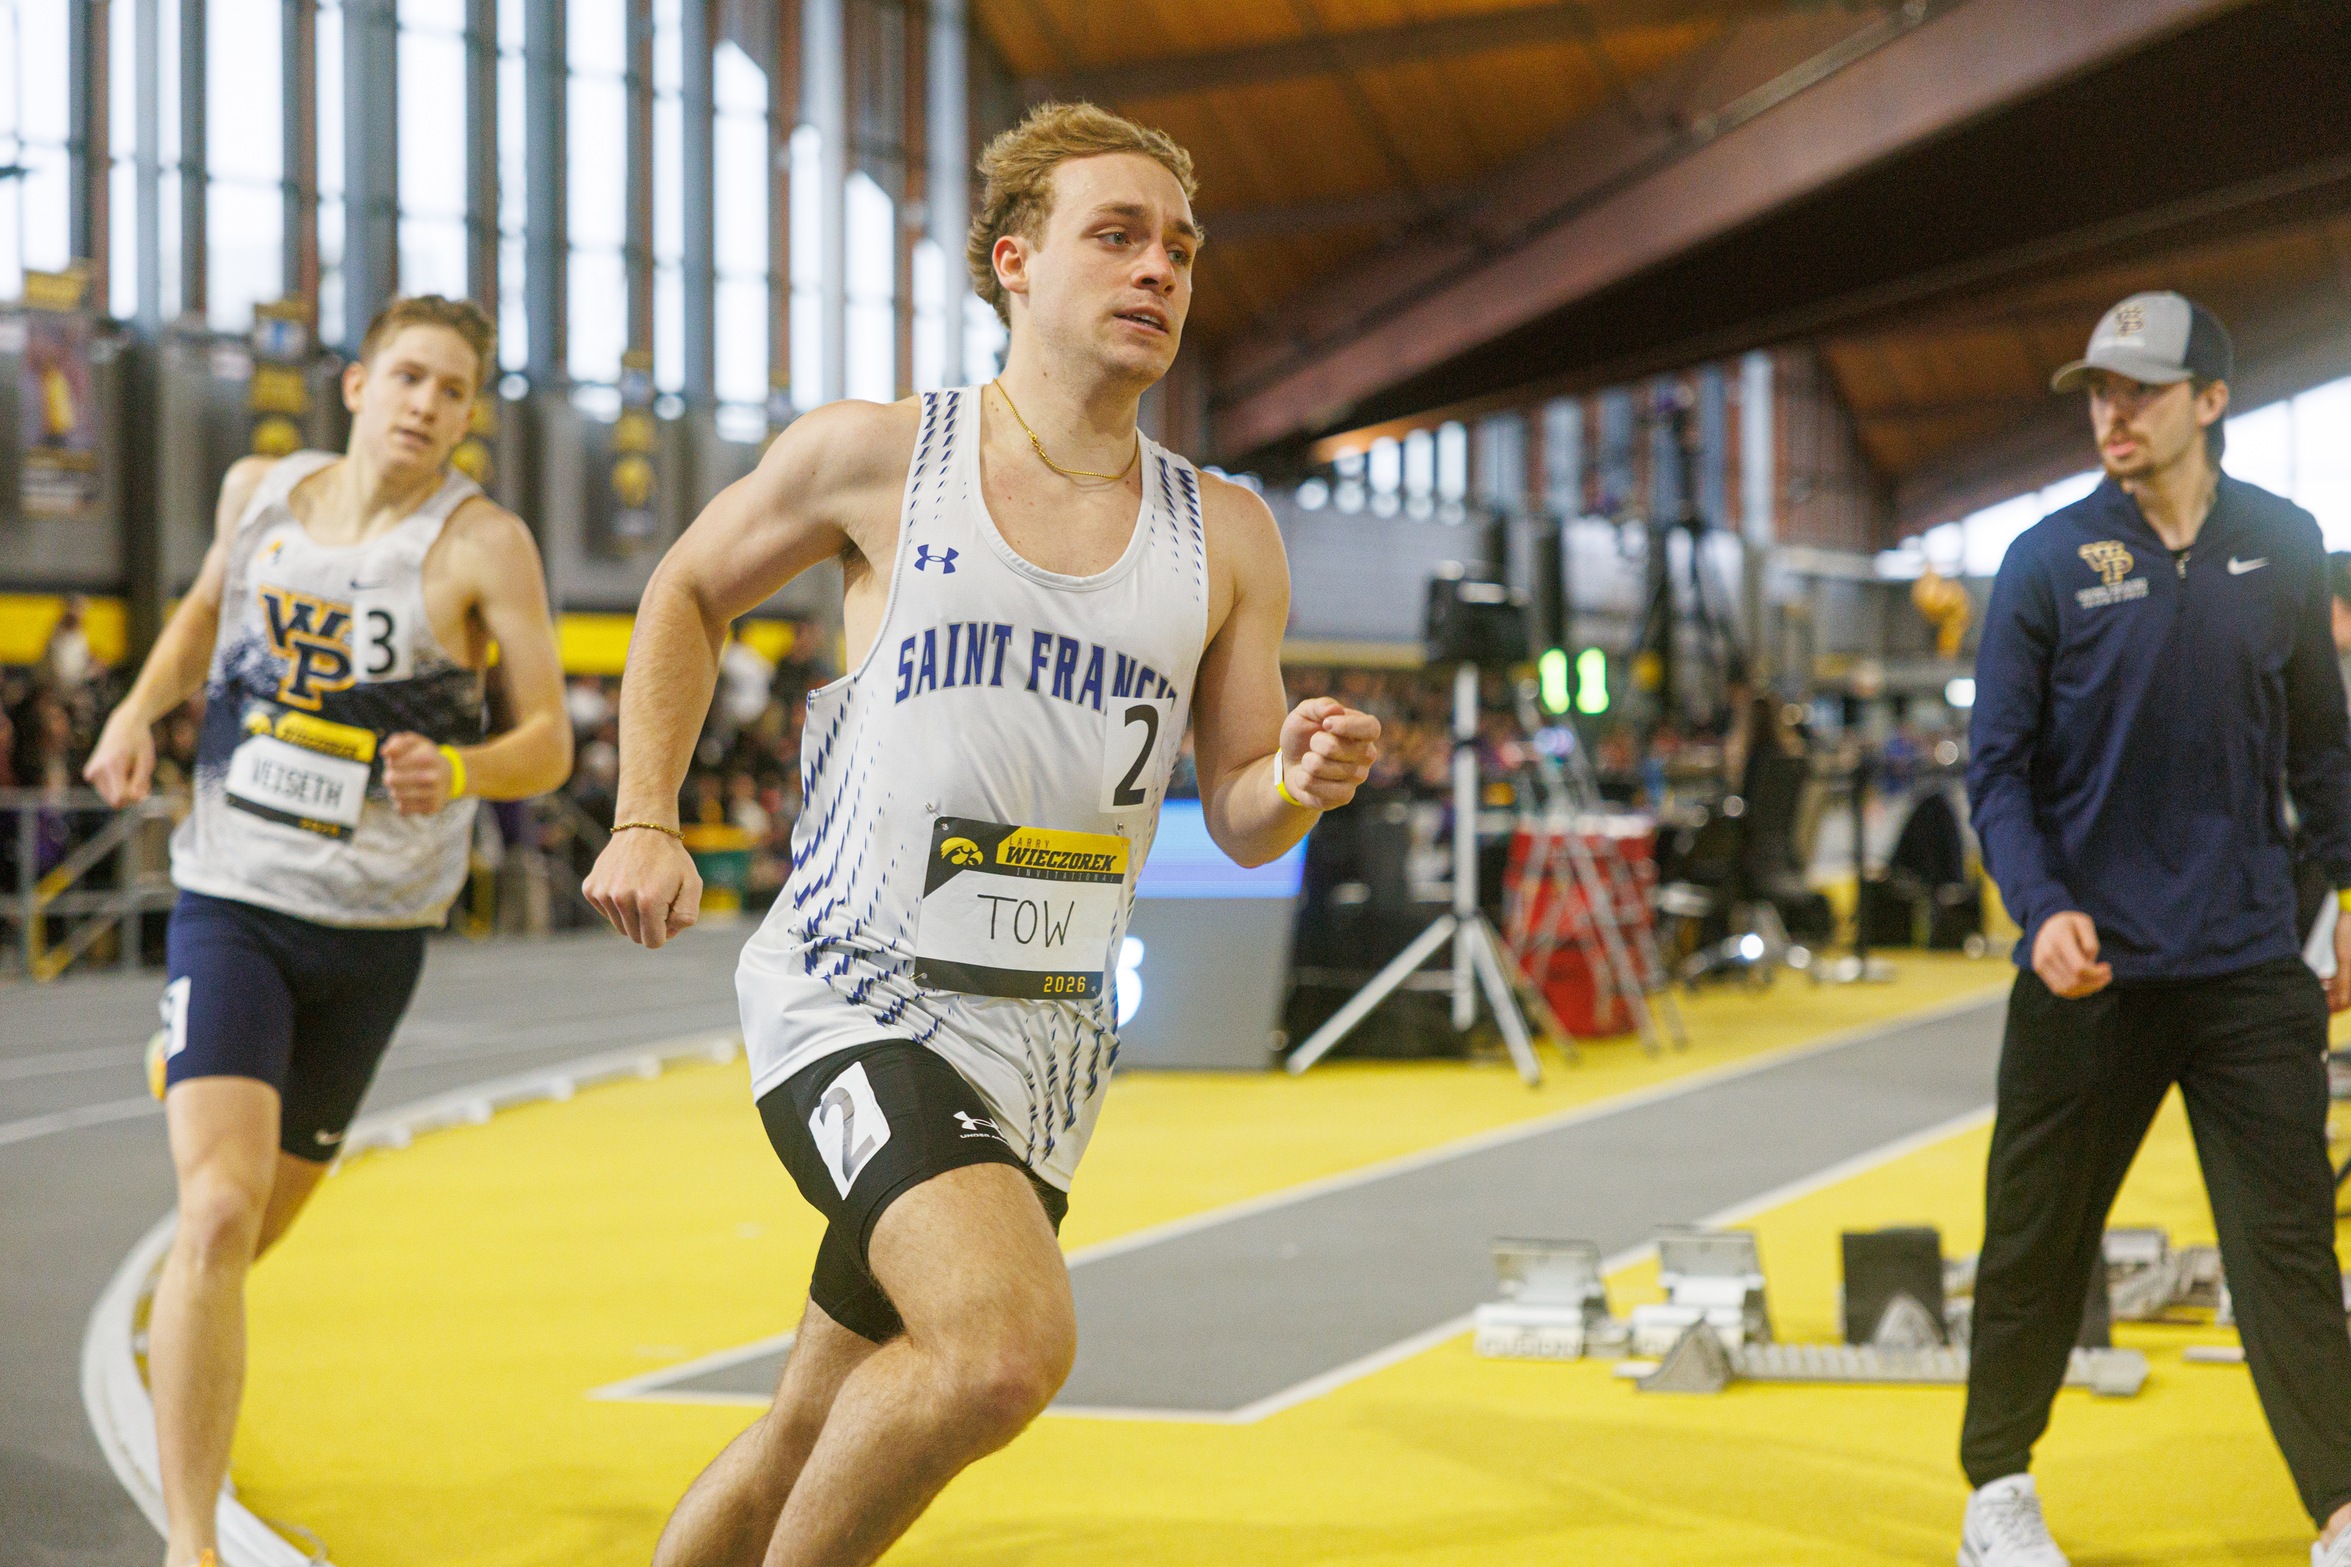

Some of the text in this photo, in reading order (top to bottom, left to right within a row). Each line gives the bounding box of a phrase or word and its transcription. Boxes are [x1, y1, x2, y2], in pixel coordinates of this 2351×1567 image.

[367, 609, 395, 675] 3
[893, 621, 1015, 706] SAINT
[1112, 703, 1159, 806] 2
[1005, 845, 1118, 872] WIECZOREK
[1008, 835, 1051, 849] LARRY
[1016, 867, 1115, 883] INVITATIONAL
[977, 893, 1075, 948] TOW
[1043, 975, 1086, 993] 2026
[819, 1086, 877, 1183] 2
